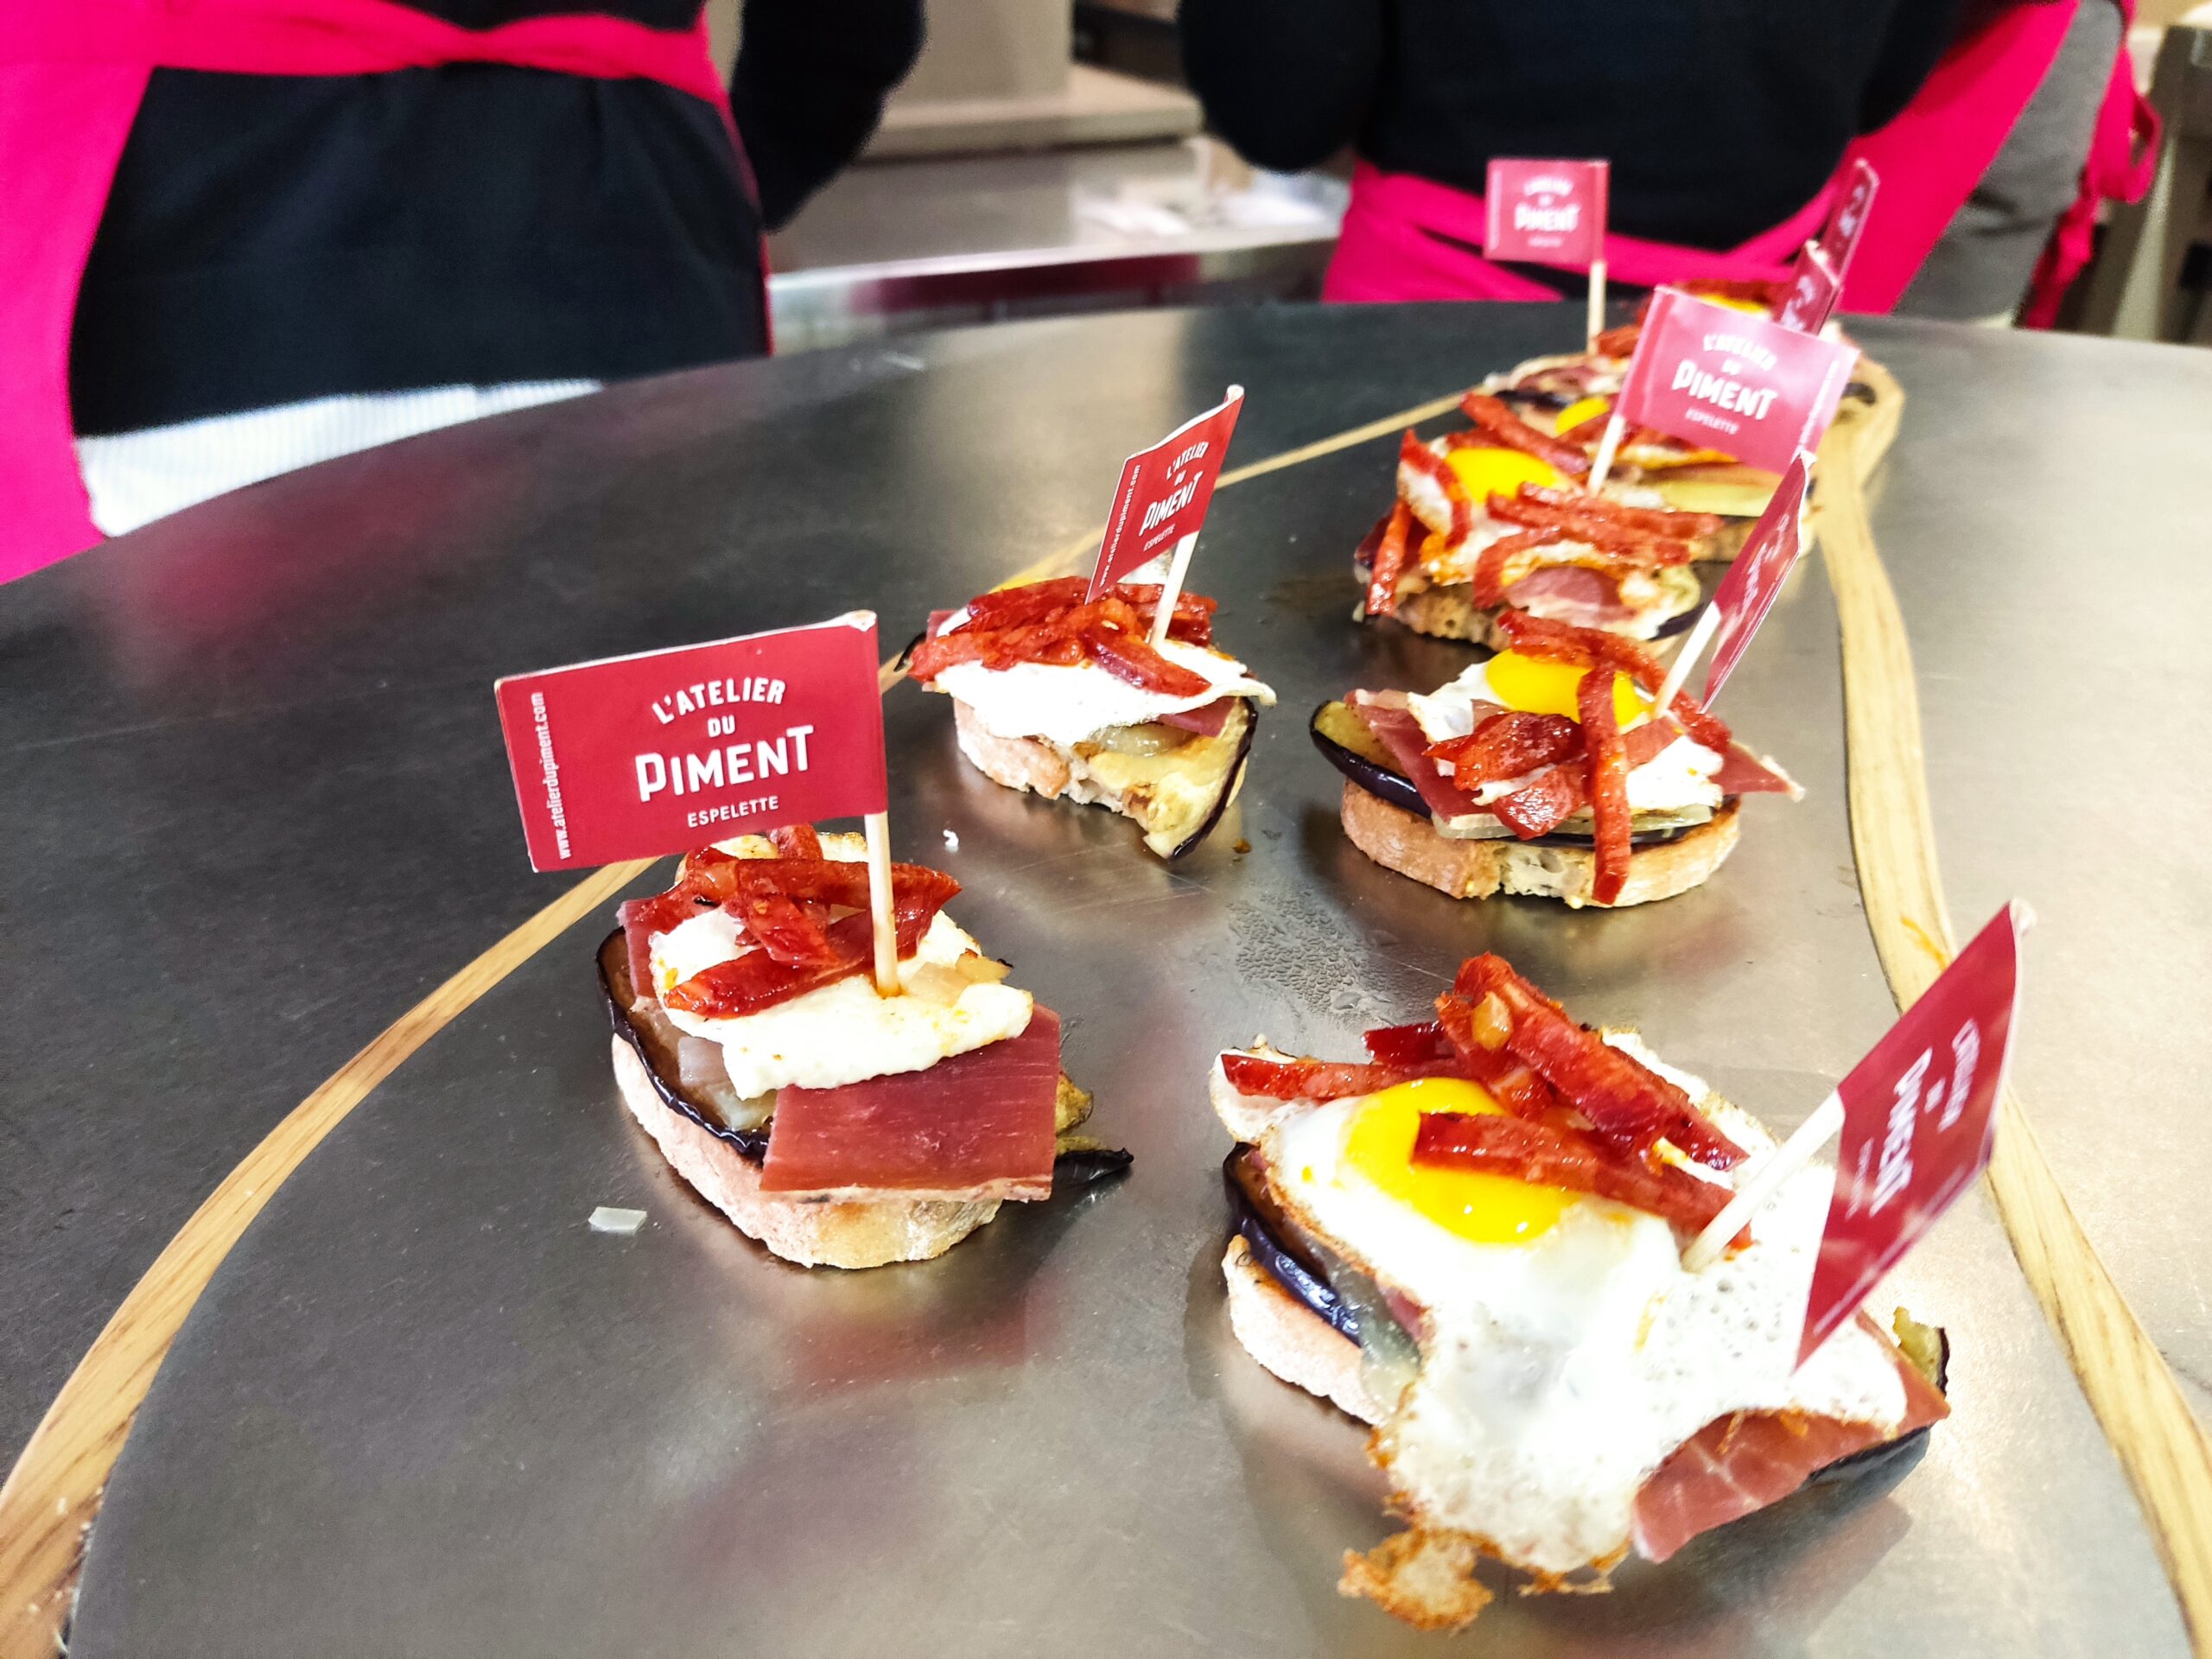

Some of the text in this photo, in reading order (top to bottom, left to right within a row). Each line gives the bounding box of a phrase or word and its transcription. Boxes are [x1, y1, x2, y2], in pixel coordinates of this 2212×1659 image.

[1671, 359, 1779, 421] PIMENT
[1166, 442, 1209, 480] L'ATELIER
[1099, 464, 1141, 588] www.atelierdupiment.com
[1139, 471, 1204, 537] PIMENT
[1143, 524, 1176, 552] ESPELETTE
[652, 677, 786, 725] L'ATELIER
[707, 715, 736, 737] DU
[530, 692, 572, 860] www.atelierdupiment.com
[634, 725, 814, 803] PIMENT
[687, 795, 779, 828] ESPELETTE
[1870, 1046, 1933, 1218] PIMENT
